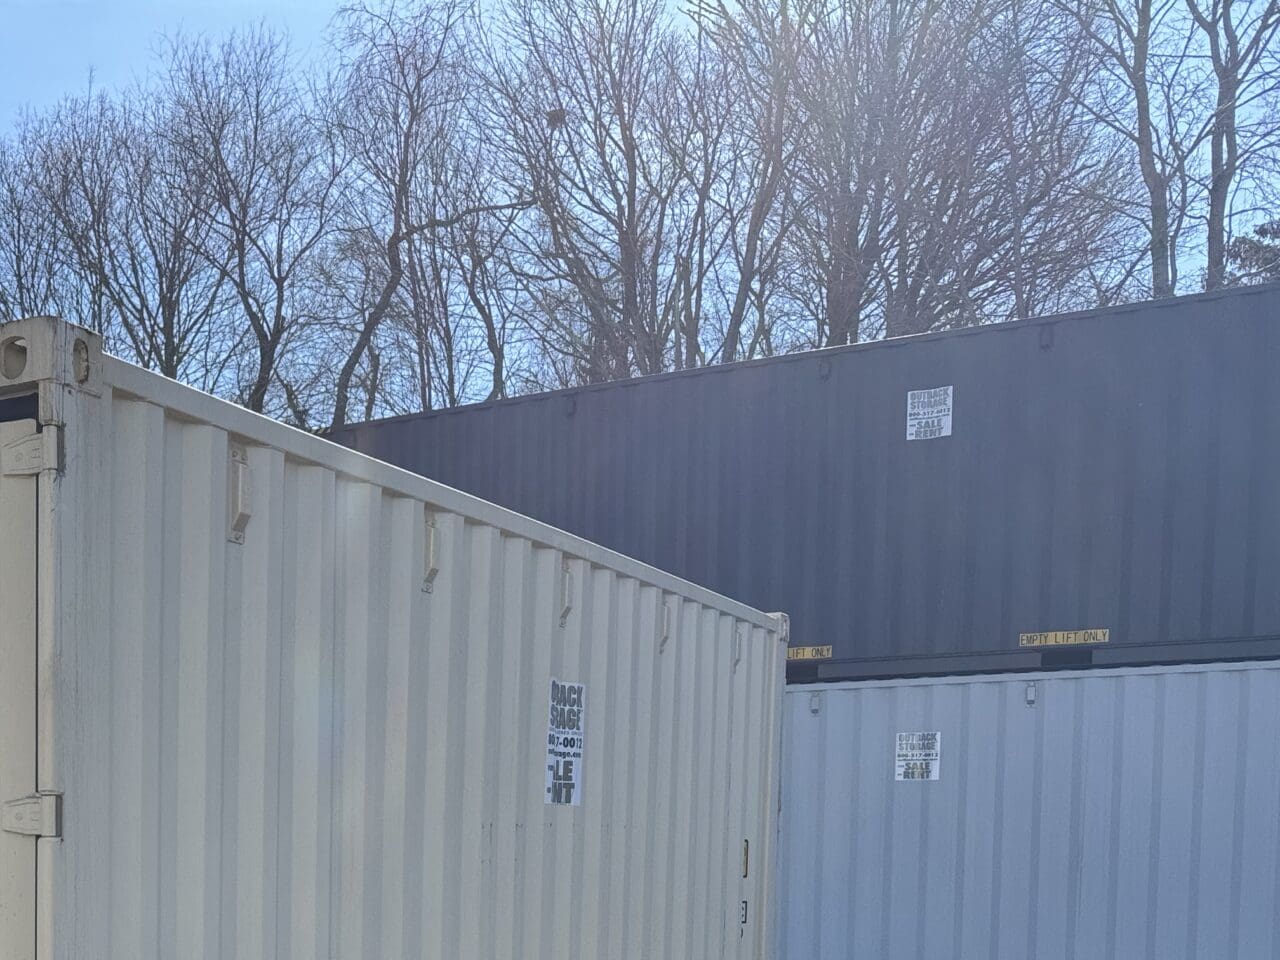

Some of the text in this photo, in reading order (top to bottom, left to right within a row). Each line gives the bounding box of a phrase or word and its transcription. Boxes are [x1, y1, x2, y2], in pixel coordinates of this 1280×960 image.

[1020, 630, 1108, 645] EMPTY LIFT ONLY
[812, 647, 831, 657] ONLY
